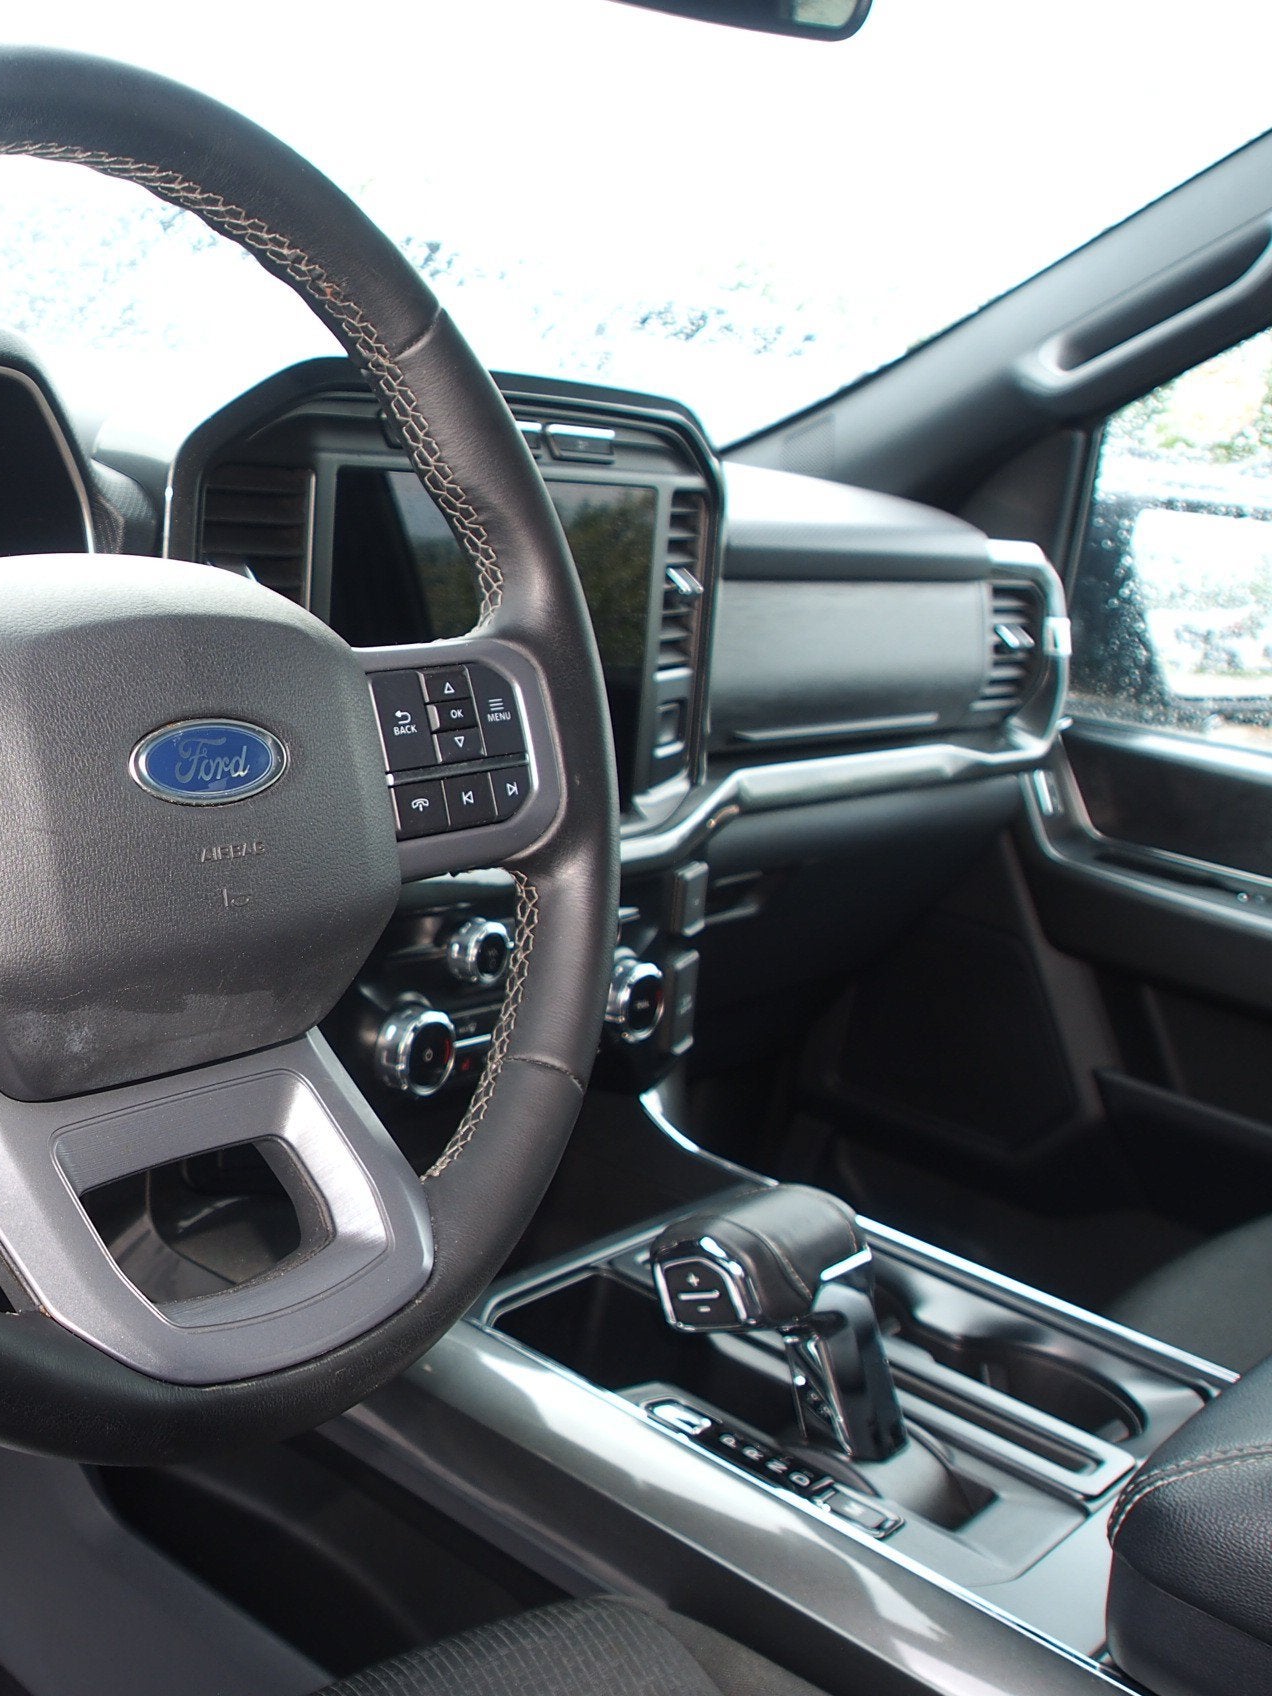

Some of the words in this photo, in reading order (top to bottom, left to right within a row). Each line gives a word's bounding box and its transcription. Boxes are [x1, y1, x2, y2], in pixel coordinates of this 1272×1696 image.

[450, 709, 464, 719] OK
[487, 712, 511, 722] MENU
[393, 725, 418, 736] BACK
[175, 736, 250, 784] Ford
[765, 1458, 788, 1474] N
